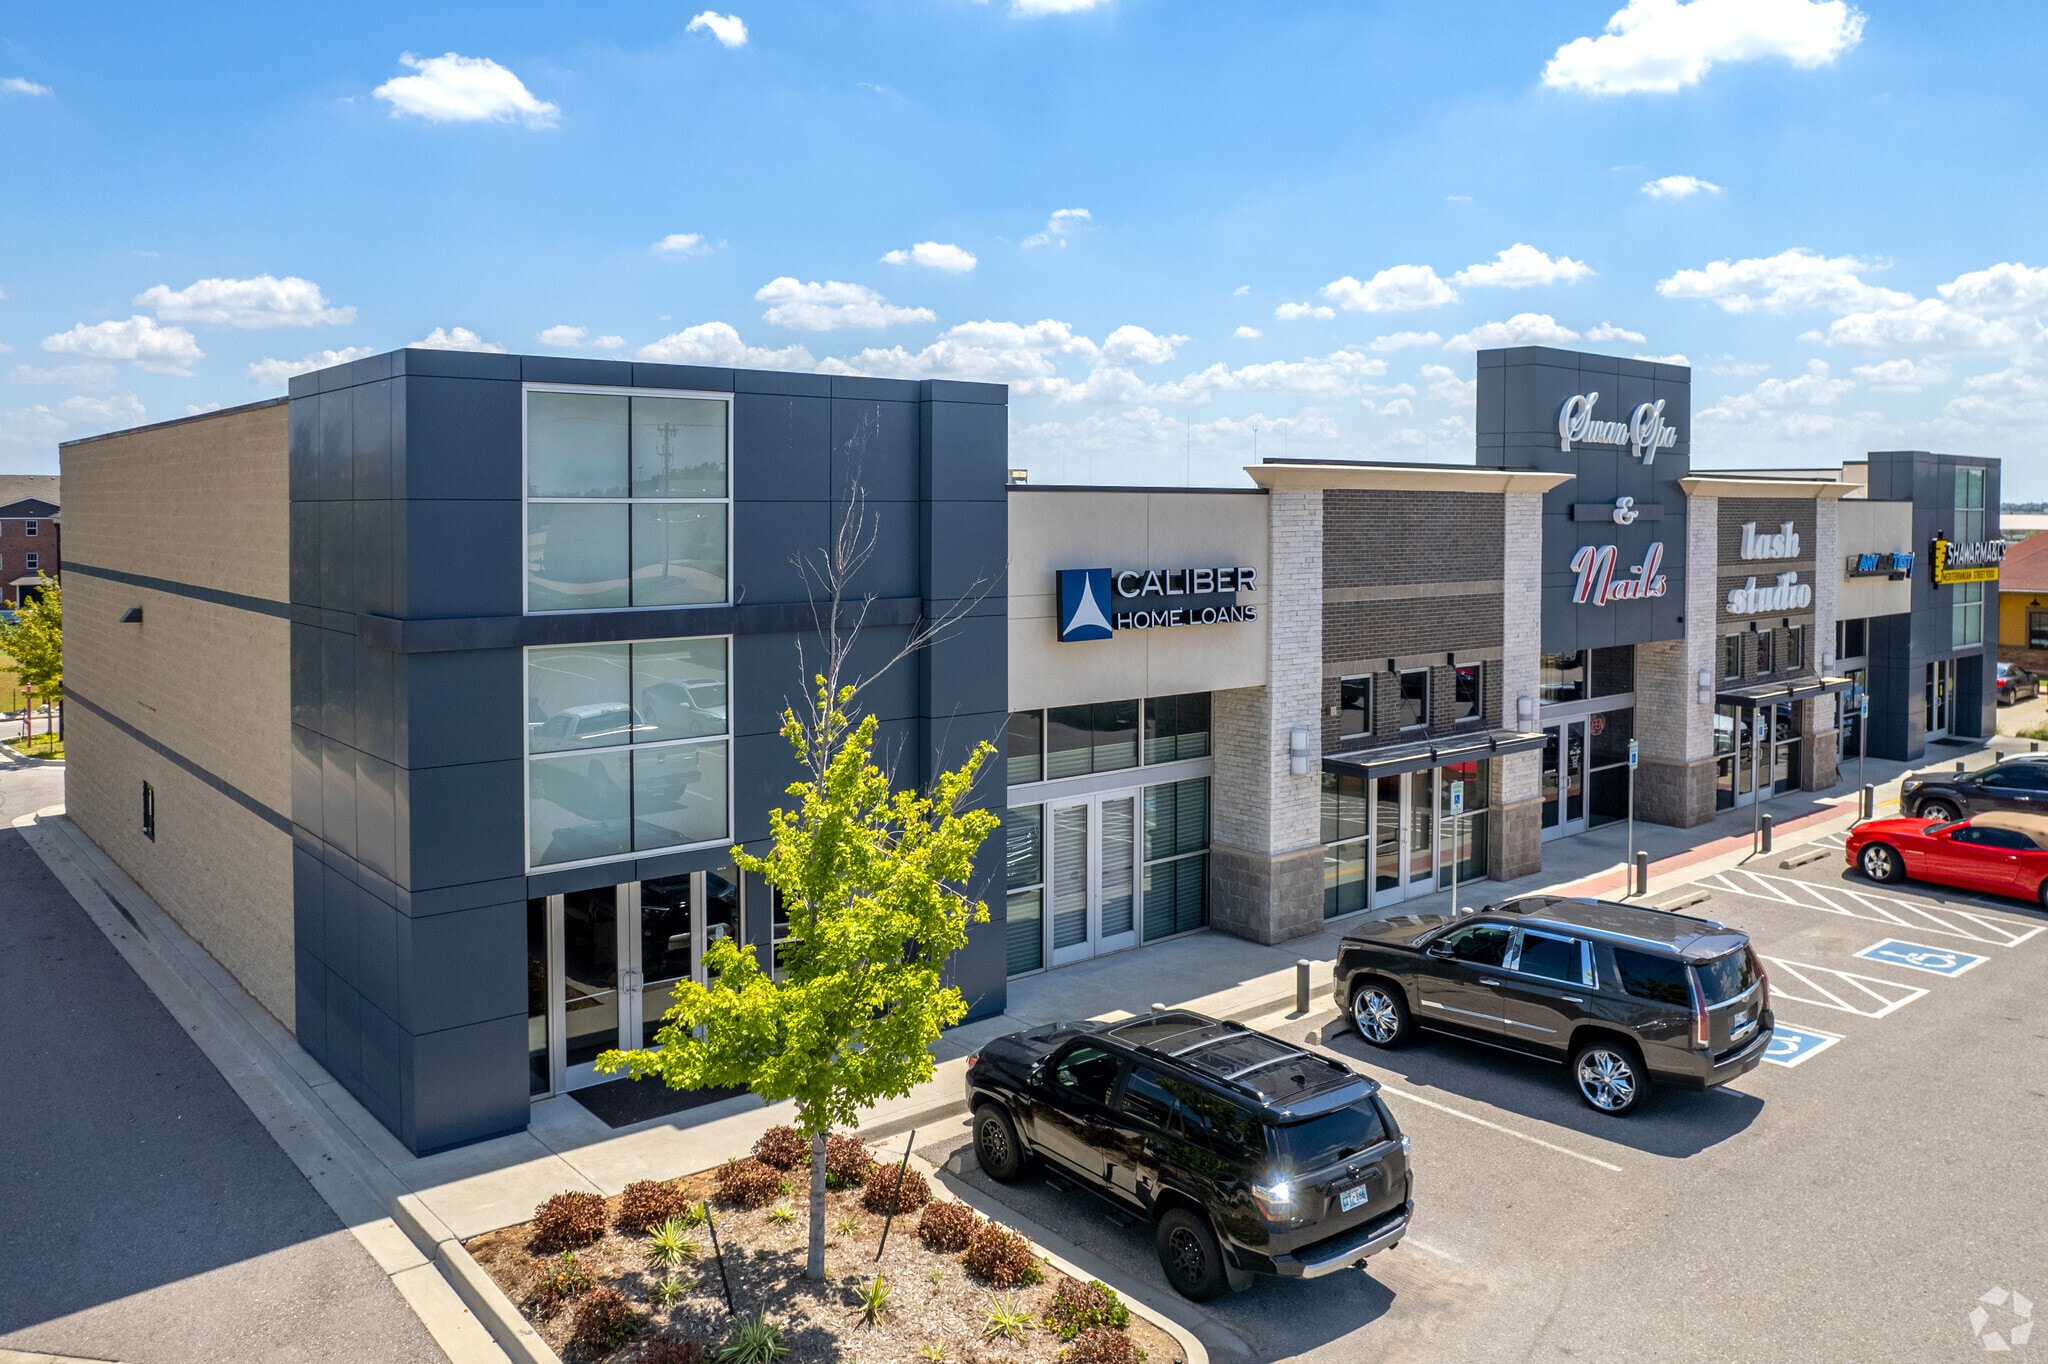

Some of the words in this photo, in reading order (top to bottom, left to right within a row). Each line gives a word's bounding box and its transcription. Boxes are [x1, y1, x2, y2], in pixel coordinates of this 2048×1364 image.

[1559, 391, 1629, 452] Swan
[1630, 399, 1677, 465] Spa
[1613, 496, 1639, 525] &
[1741, 521, 1800, 560] lash
[1570, 542, 1667, 606] Nails
[1859, 553, 1879, 571] ANY
[1973, 570, 1985, 580] STREET
[1986, 569, 1995, 579] FOOD
[1117, 566, 1258, 598] CALIBER
[1726, 571, 1811, 614] studio
[1117, 608, 1183, 630] HOME
[1189, 605, 1258, 625] LOANS
